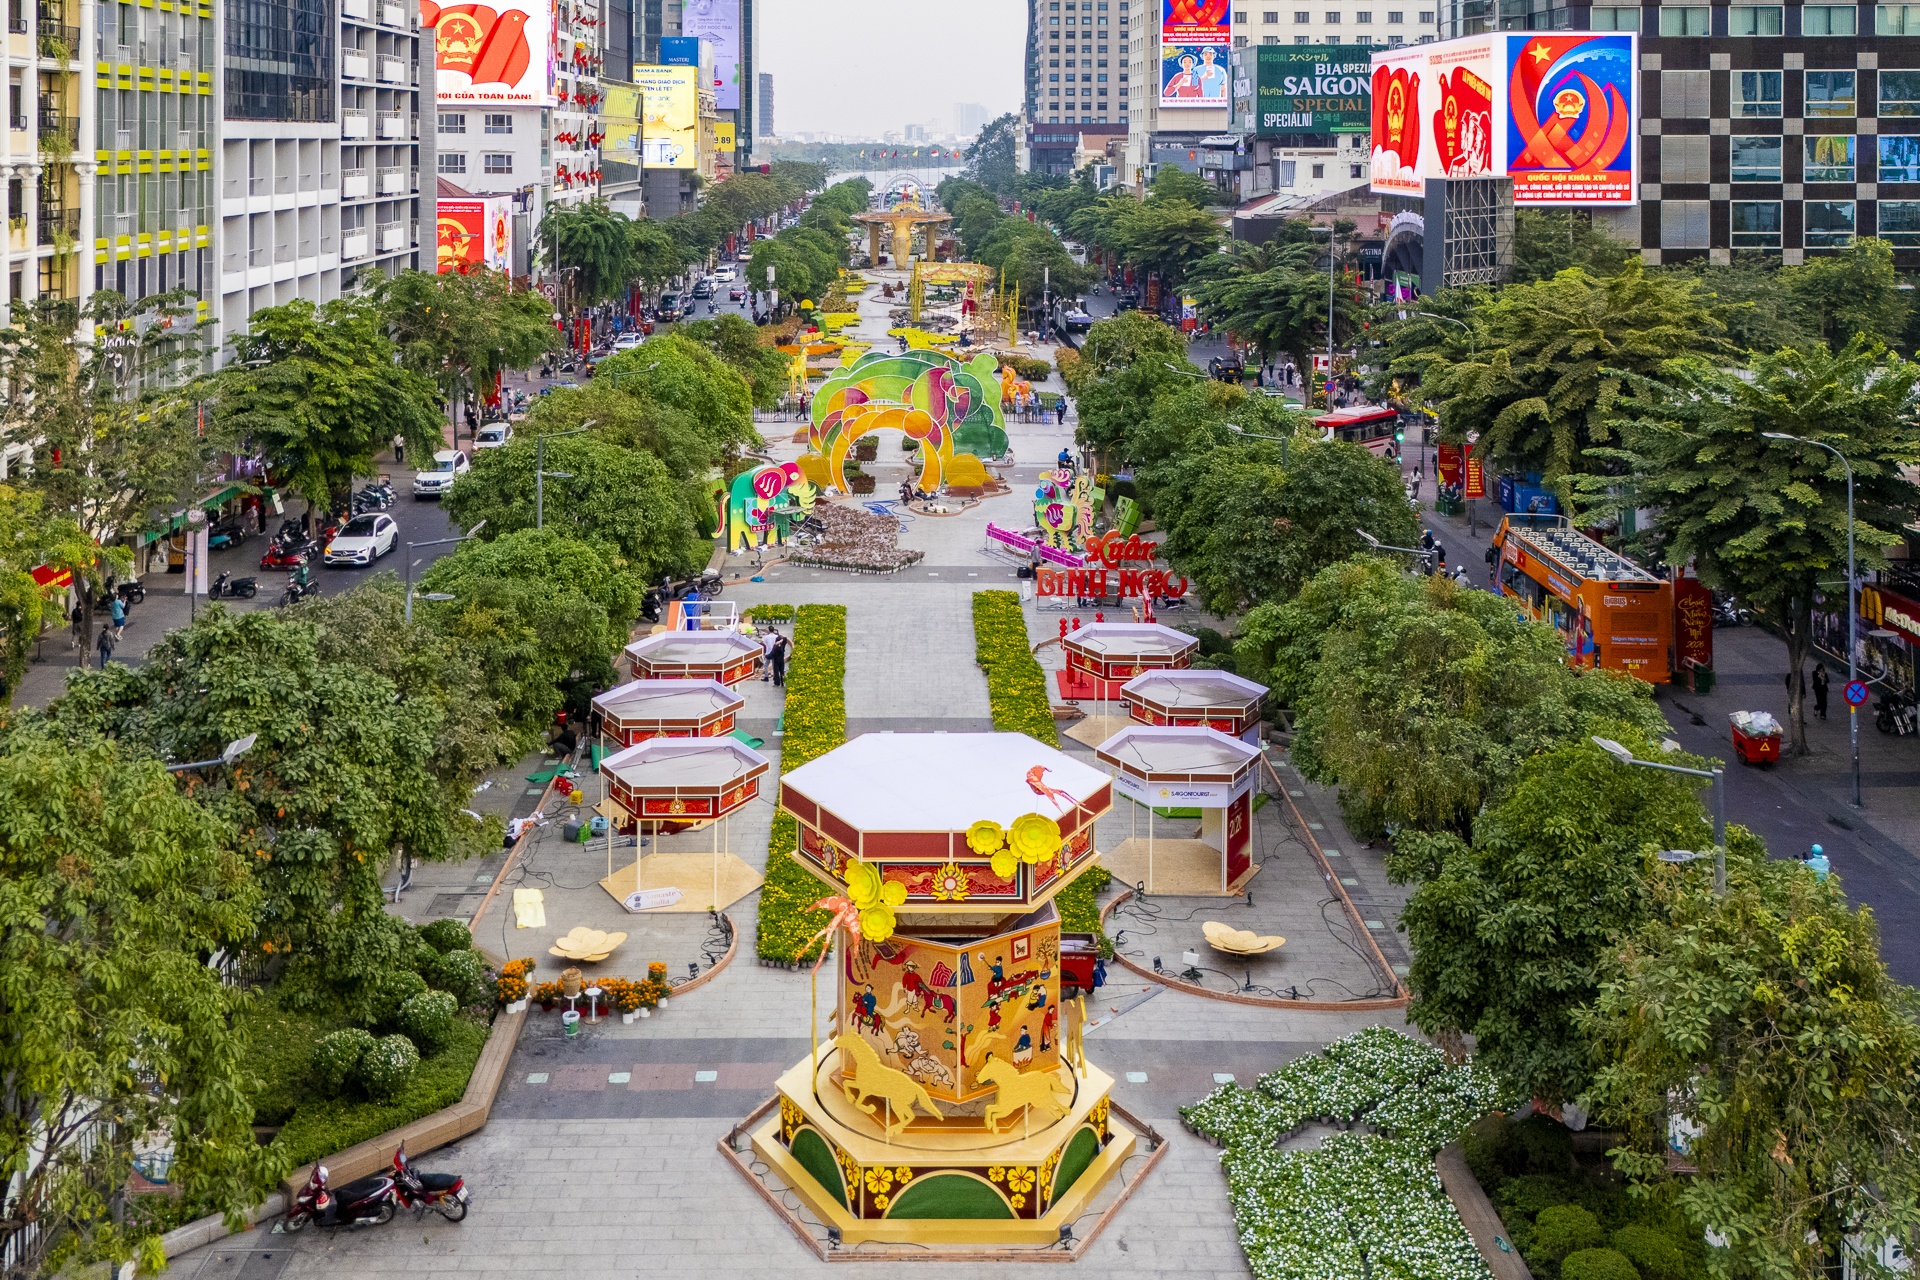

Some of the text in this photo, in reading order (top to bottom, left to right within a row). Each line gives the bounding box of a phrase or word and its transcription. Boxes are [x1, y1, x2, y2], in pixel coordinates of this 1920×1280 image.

[1260, 52, 1287, 62] SPÉCIAL
[1289, 53, 1329, 62] スペシャル
[1315, 63, 1342, 76] BIA
[1259, 85, 1283, 96] พิเศษ
[1283, 76, 1372, 96] SAIGON
[455, 90, 475, 99] CỦA
[1293, 98, 1367, 112] SPECIAL
[1264, 111, 1313, 128] SPECIÁLNÍ
[1527, 172, 1550, 182] QUỐC
[1552, 173, 1566, 182] HỘI
[1568, 173, 1591, 181] KHÓA
[1359, 248, 1382, 256] KATINA
[1086, 529, 1158, 570] Xuân
[645, 891, 676, 899] Namaste
[651, 899, 670, 907] India
